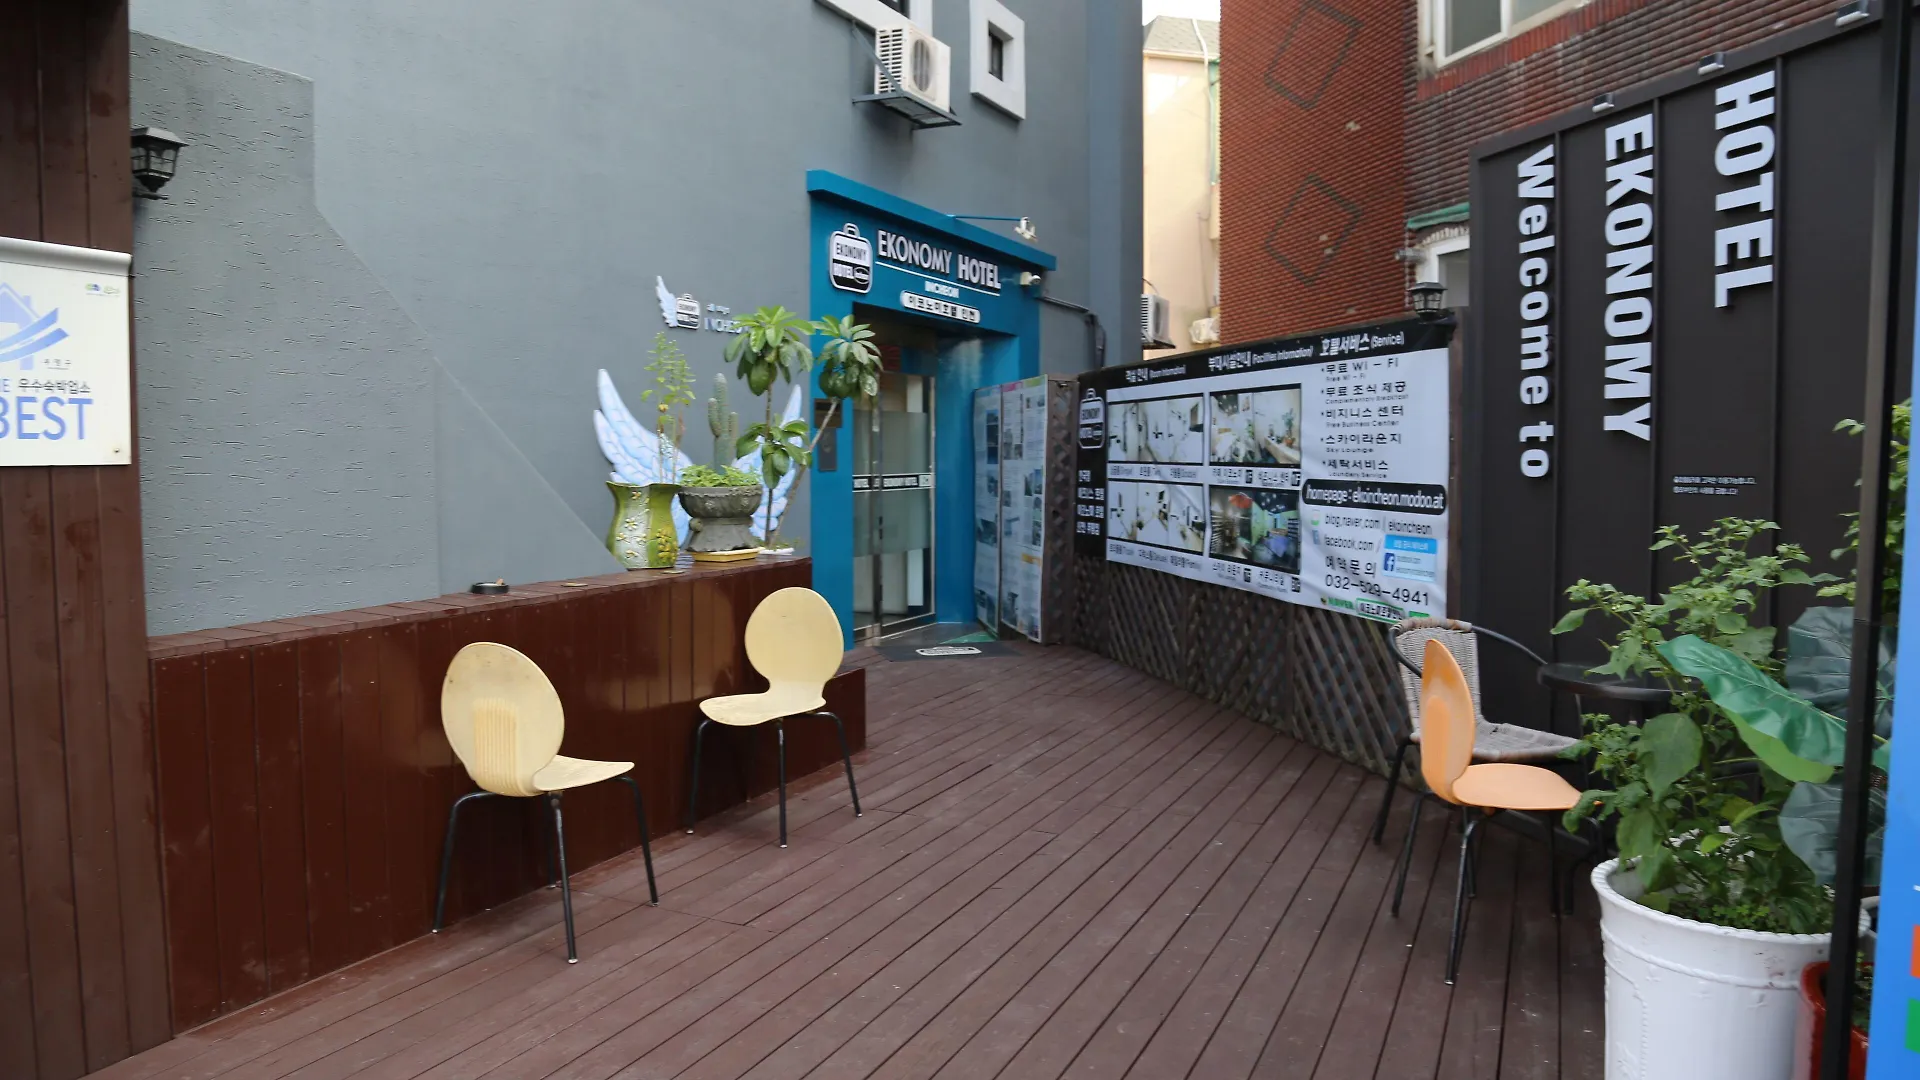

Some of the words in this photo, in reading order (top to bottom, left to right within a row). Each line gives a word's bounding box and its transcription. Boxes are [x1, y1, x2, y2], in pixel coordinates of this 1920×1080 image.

[1714, 70, 1775, 308] HOTEL
[836, 242, 868, 261] EKONOMY
[877, 229, 953, 275] EKONOMY
[958, 254, 1002, 290] HOTEL
[1518, 144, 1555, 405] Welcome
[1603, 113, 1653, 441] EKONOMY
[925, 280, 960, 298] INCHEON
[1320, 333, 1370, 356] 호텔서비스
[1326, 363, 1348, 375] 무료
[18, 378, 91, 395] 우수숙박업소
[1326, 386, 1348, 397] 무료
[1353, 384, 1377, 396] 조식
[1382, 381, 1406, 393] 제공
[1326, 407, 1372, 419] 비지니스
[1377, 405, 1404, 417] 센터
[1325, 433, 1402, 445] 스카이라운지
[1519, 421, 1554, 478] to
[1327, 459, 1389, 470] 세탁서비스
[1306, 484, 1348, 504] homepage
[1324, 534, 1374, 552] facebook.com
[1325, 574, 1430, 606] 032-529-4941
